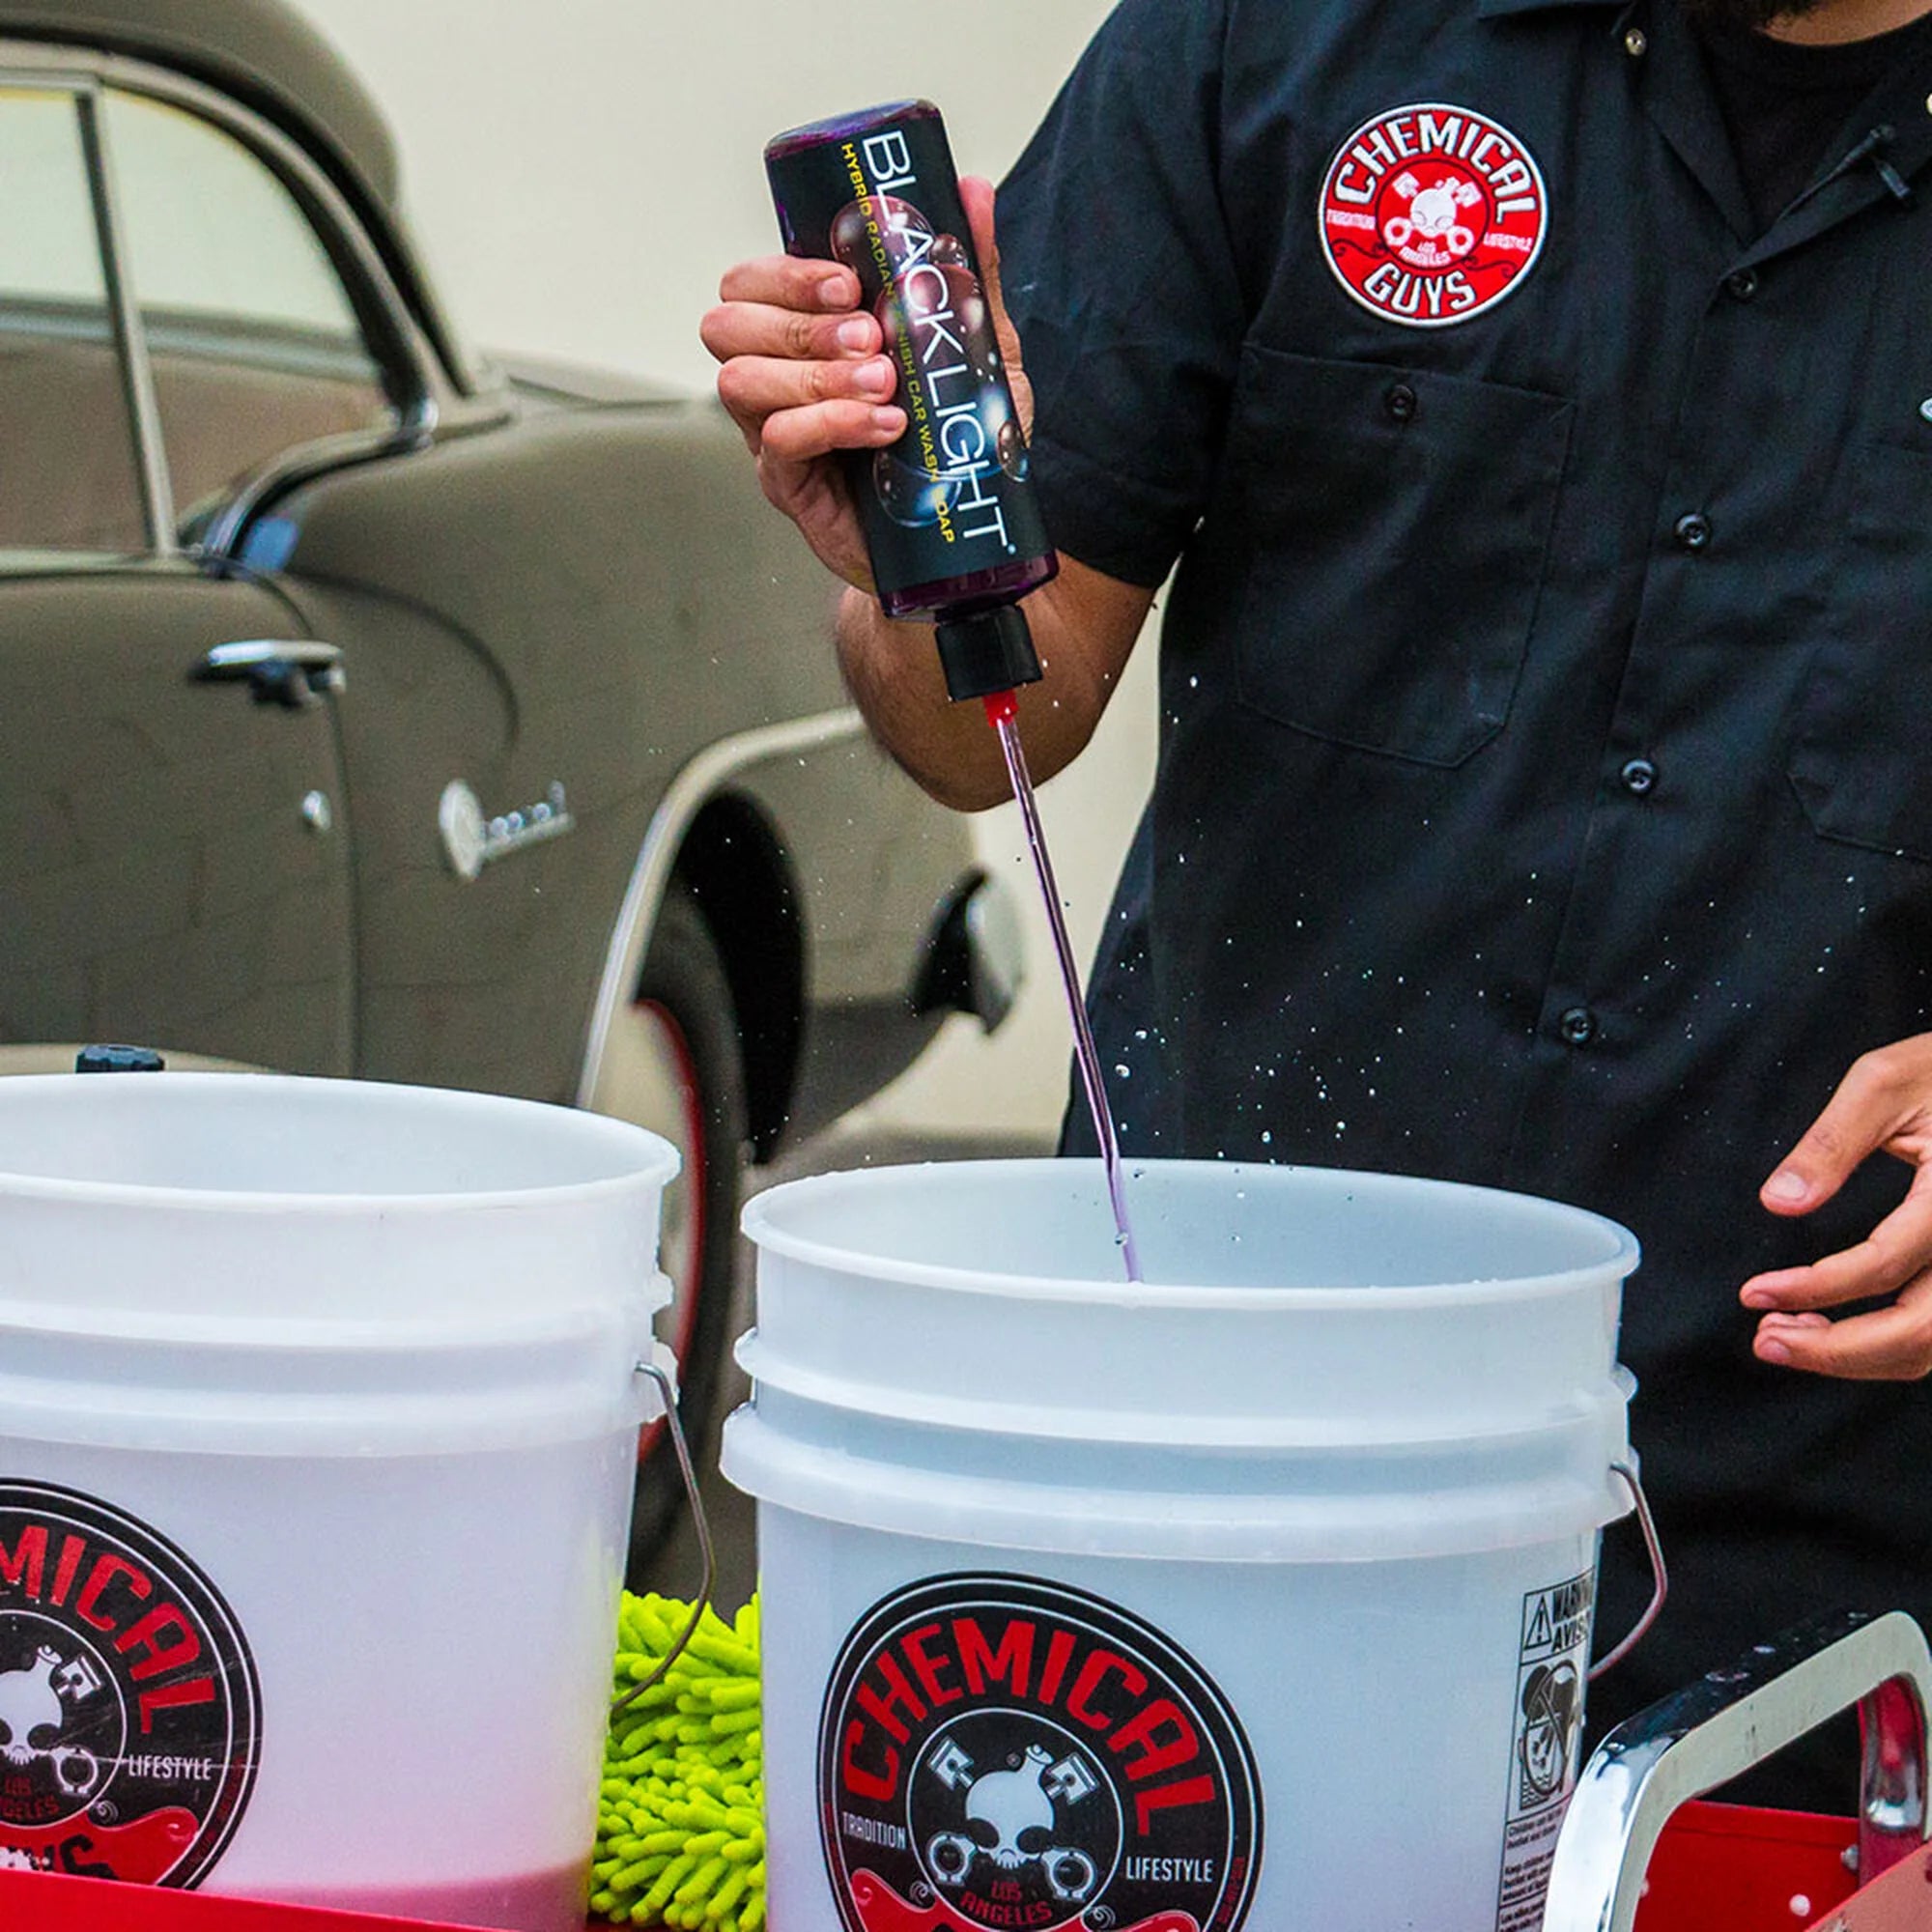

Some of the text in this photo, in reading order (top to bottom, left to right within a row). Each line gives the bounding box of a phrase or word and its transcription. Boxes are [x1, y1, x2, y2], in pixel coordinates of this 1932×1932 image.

[1334, 113, 1537, 224] CHEMICAL
[840, 142, 873, 217] HYBRID
[908, 380, 927, 421] CAR
[919, 424, 940, 483] WASH
[1363, 262, 1477, 316] GUYS
[862, 129, 1009, 548] BLACKLIGHT
[842, 1617, 1216, 1836] CHEMICAL
[128, 1753, 212, 1780] LIFESTYLE
[841, 1810, 906, 1850] TRADITION
[991, 1879, 1022, 1901] LOS
[1125, 1858, 1214, 1883] LIFESTYLE
[959, 1889, 1053, 1925] ANGELES
